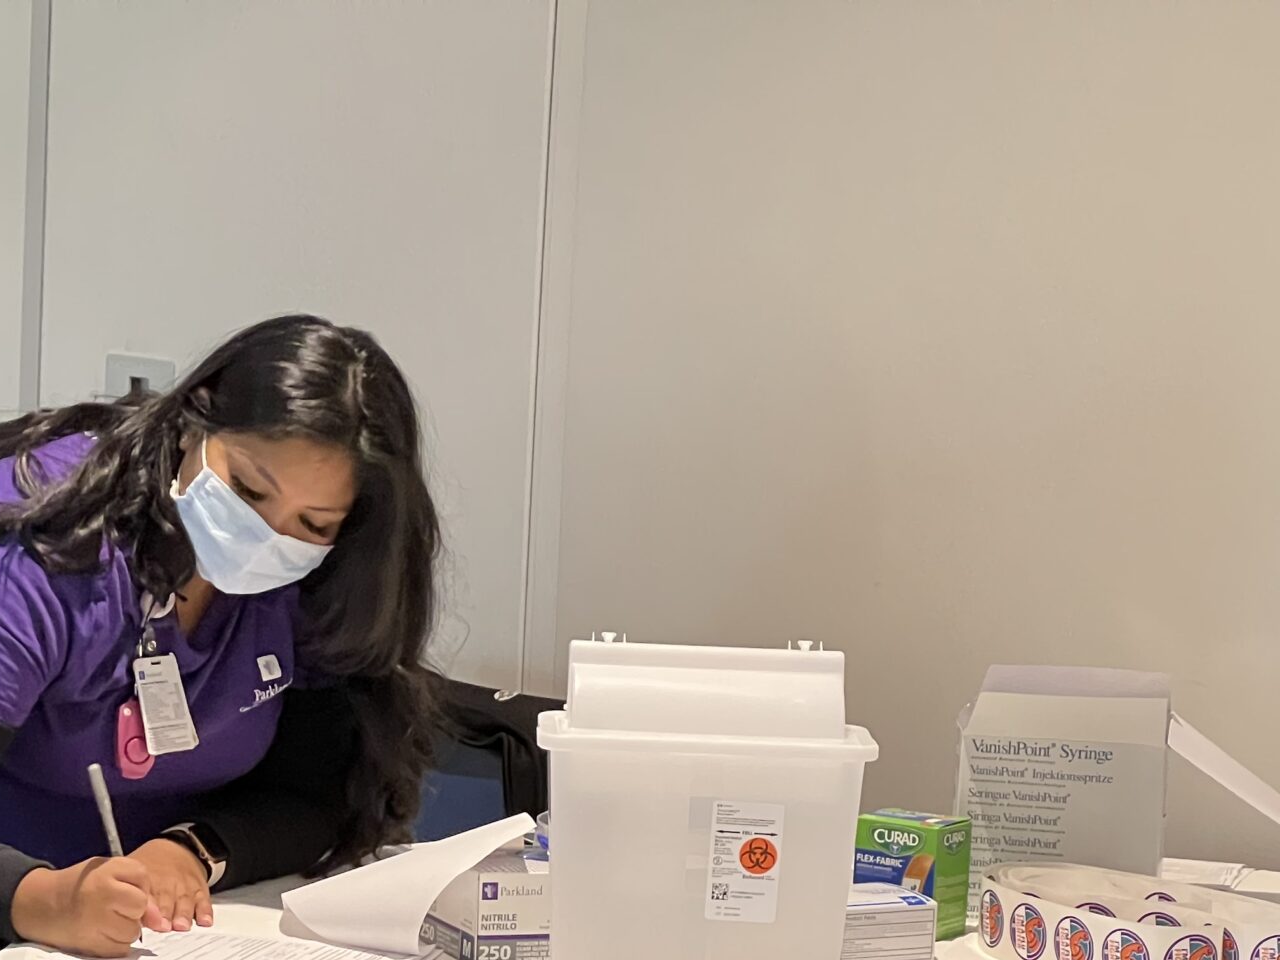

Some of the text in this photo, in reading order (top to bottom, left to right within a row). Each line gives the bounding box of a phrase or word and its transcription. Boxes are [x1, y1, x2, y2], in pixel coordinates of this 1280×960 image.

[1060, 743, 1113, 765] Syringe
[1032, 768, 1114, 785] Injektionsspritze
[968, 787, 1011, 801] Seringue
[874, 828, 919, 847] CURAD
[944, 830, 966, 846] CURAD
[970, 835, 1001, 848] eringa
[856, 853, 903, 868] FLEX-FABRIC
[500, 885, 543, 897] Parkland
[481, 913, 517, 922] NITRILE
[480, 922, 517, 931] NITRILO
[462, 939, 472, 958] M
[478, 945, 512, 960] 250
